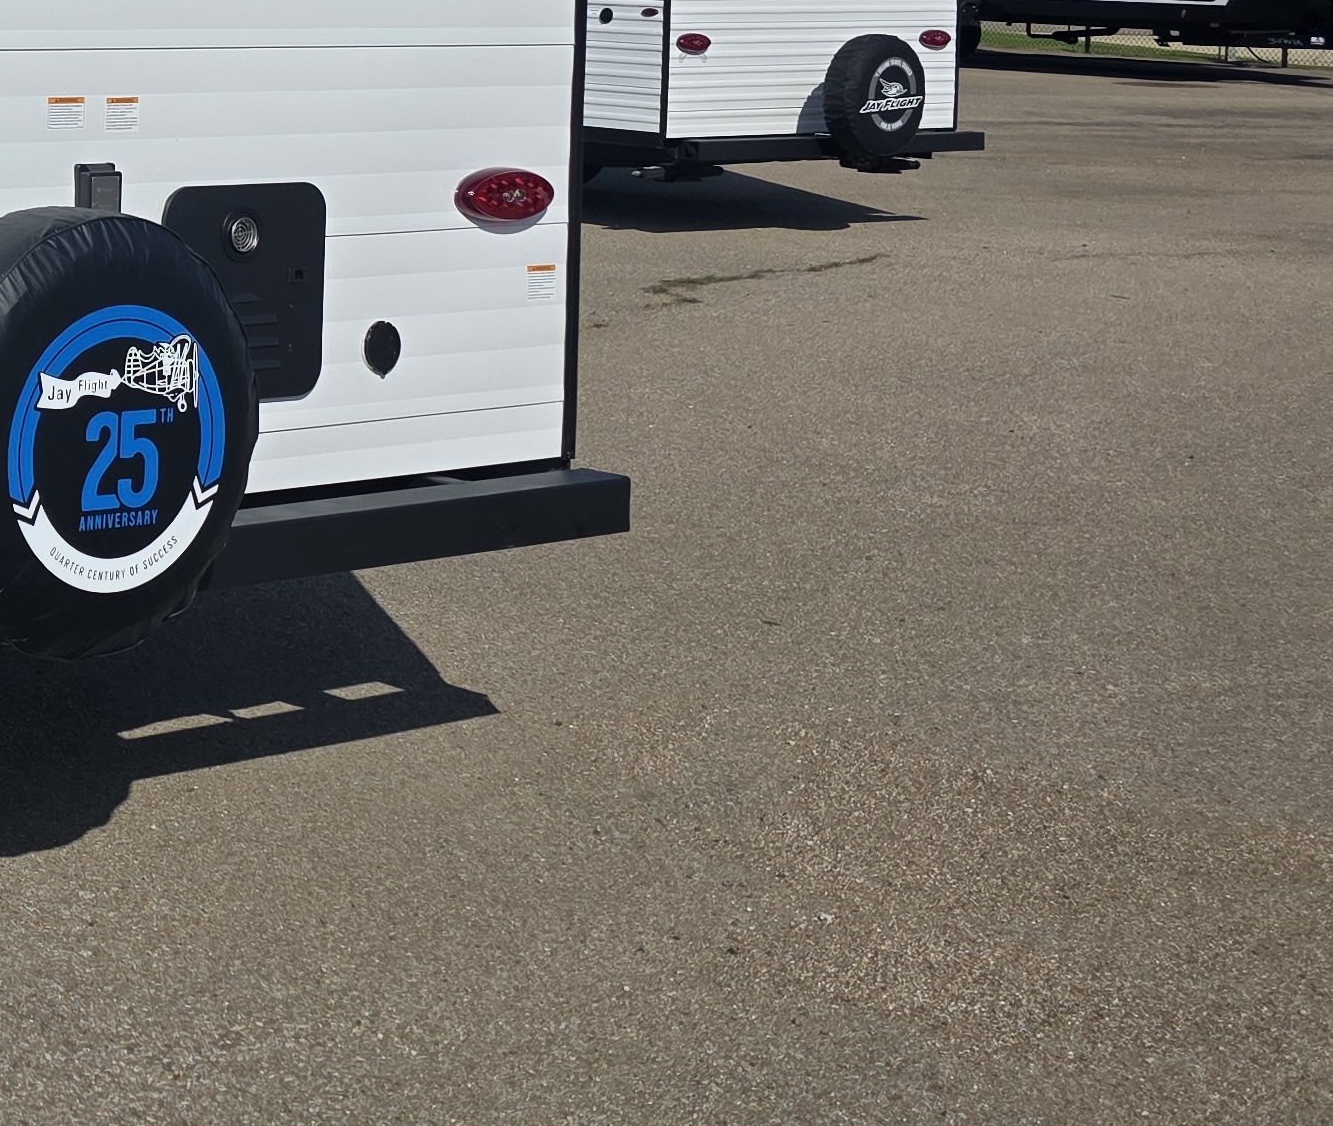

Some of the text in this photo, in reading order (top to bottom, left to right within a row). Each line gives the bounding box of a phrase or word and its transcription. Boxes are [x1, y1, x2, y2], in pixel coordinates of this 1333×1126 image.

[863, 97, 922, 111] JAY FLIGHT
[47, 379, 108, 403] Jay Flight
[79, 509, 158, 532] ANNIVERSARY
[49, 536, 178, 581] QUARTER CENTURY OF SUCCESS
